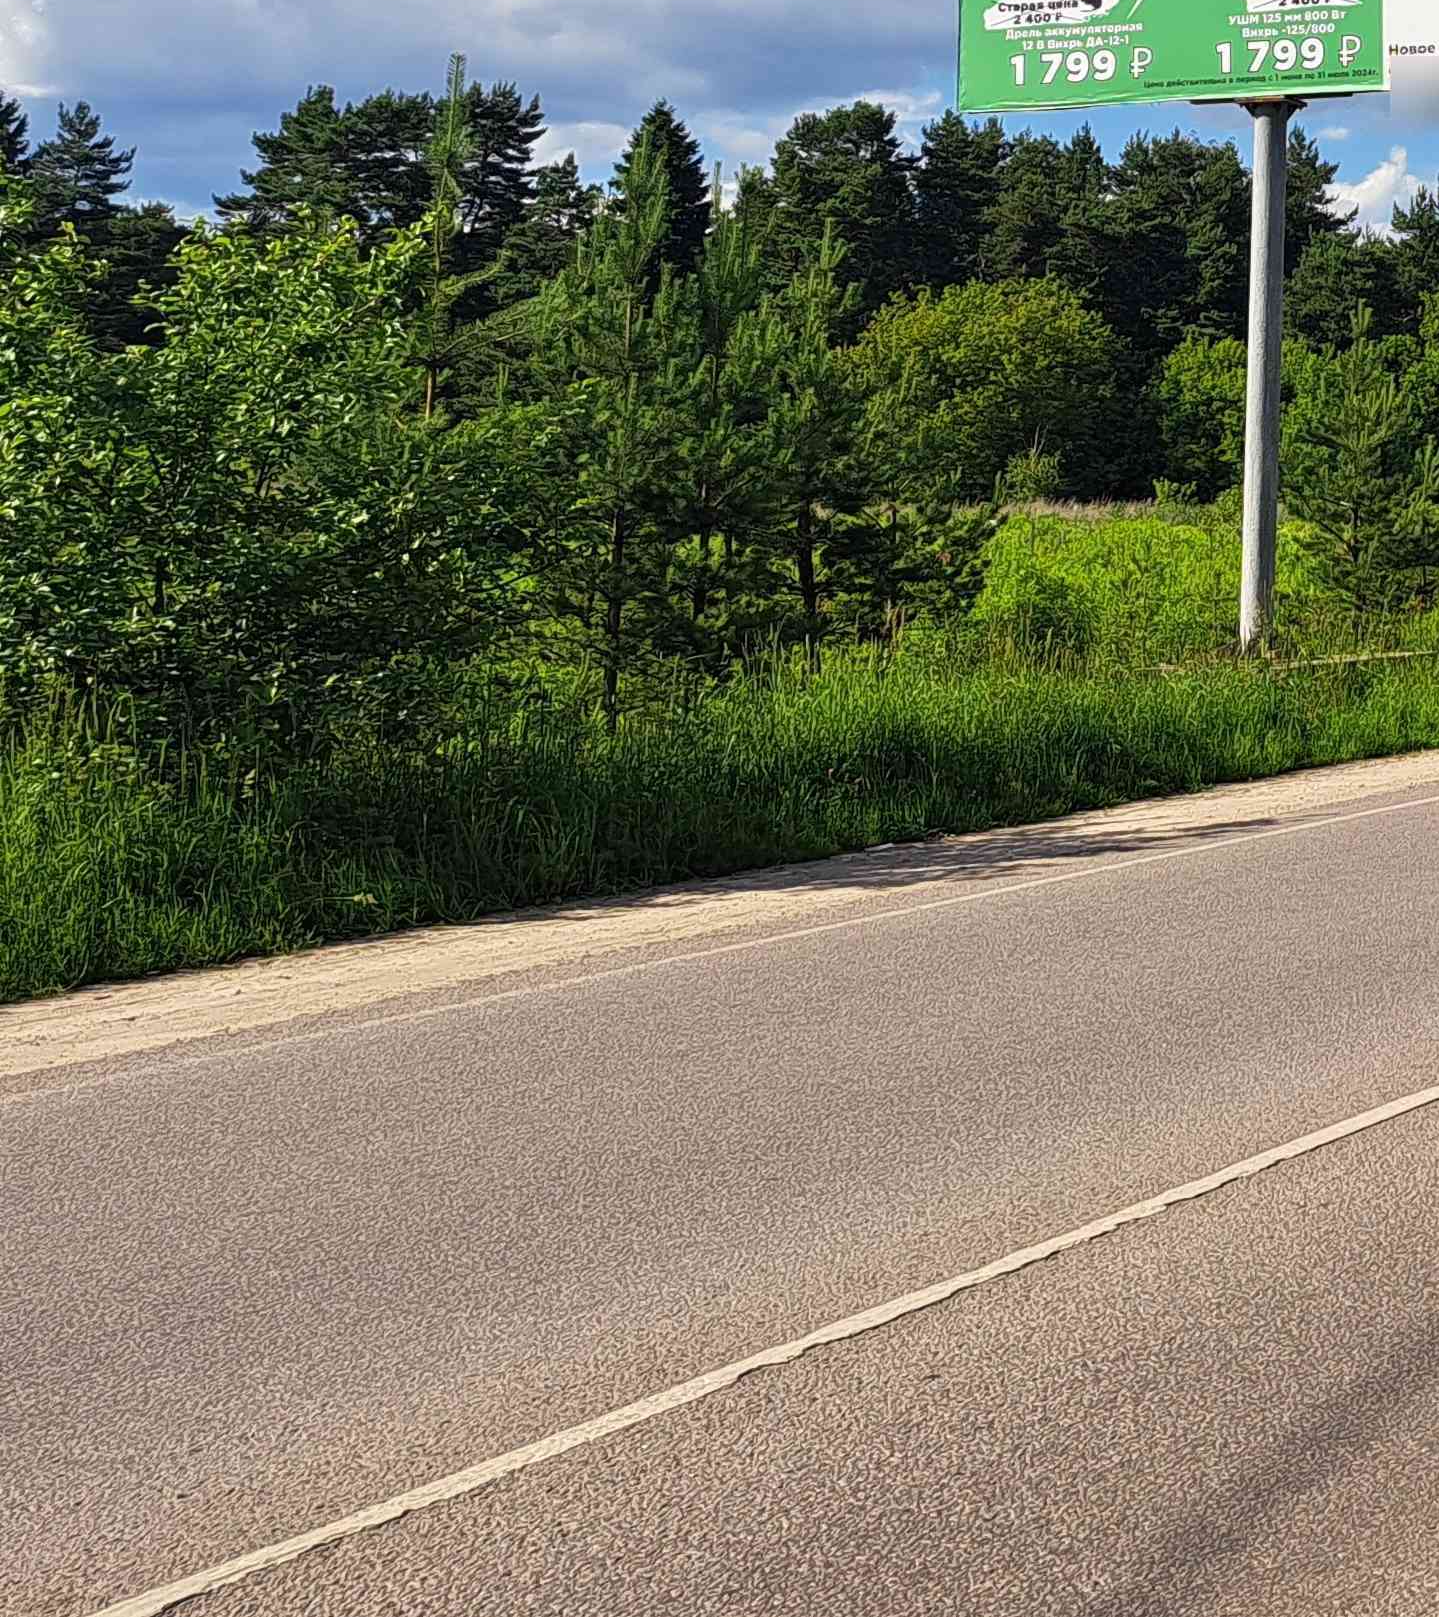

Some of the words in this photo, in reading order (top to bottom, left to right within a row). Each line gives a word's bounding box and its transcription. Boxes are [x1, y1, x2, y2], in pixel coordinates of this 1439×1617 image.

[1262, 13, 1282, 24] 125
[1304, 11, 1329, 21] 800
[1331, 10, 1347, 20] Вт
[1216, 40, 1232, 74] 1
[1246, 37, 1325, 73] 799
[1389, 43, 1436, 56] Новое
[1009, 53, 1026, 86] 1
[1040, 48, 1117, 85] 799
